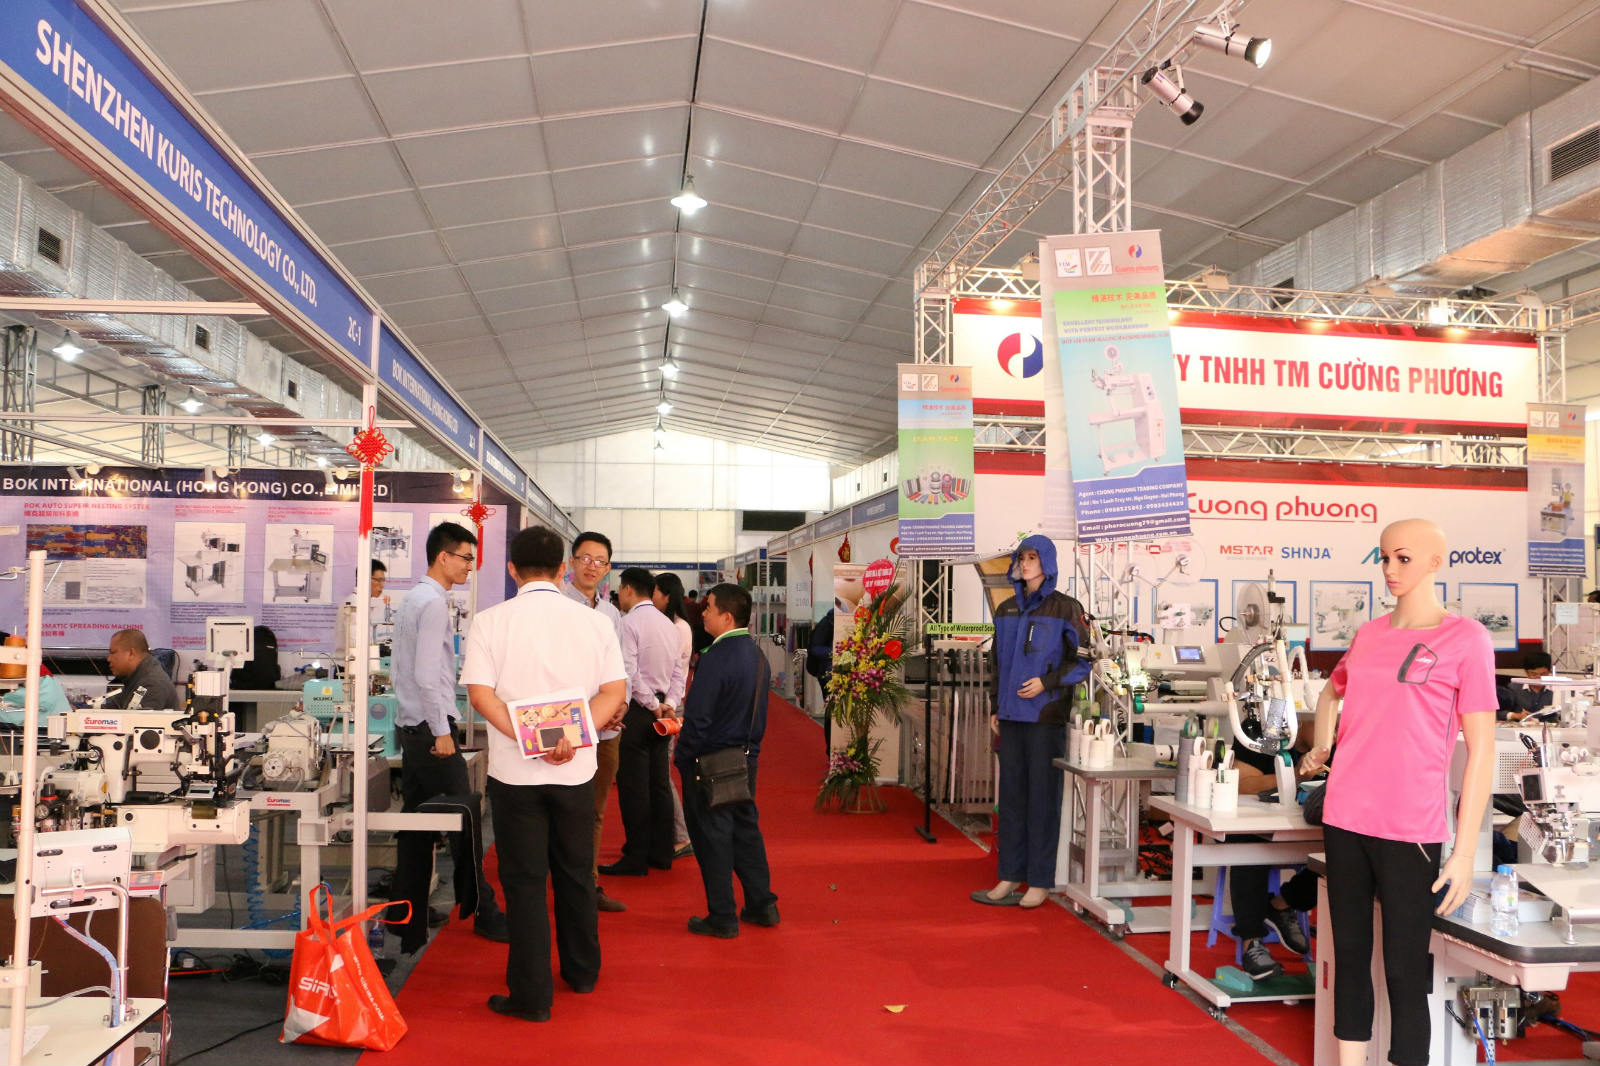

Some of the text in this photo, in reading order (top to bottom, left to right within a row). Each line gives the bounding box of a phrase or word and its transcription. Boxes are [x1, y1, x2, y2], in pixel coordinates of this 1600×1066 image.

[36, 19, 318, 308] SHENZHEN KURIS TECHNOLOGY CO., LTD.
[347, 315, 363, 347] 2C-1
[1173, 353, 1503, 398] Y TNHH TM CƯỜNG PHƯƠNG
[3, 478, 38, 490] BOK
[42, 478, 173, 493] INTERNATIONAL
[234, 481, 287, 497] KONG)
[1276, 496, 1377, 523] phuong
[1219, 545, 1273, 556] MSTAR
[1449, 547, 1503, 567] protex
[956, 625, 984, 633] Waterproof
[84, 717, 118, 726] Euromac
